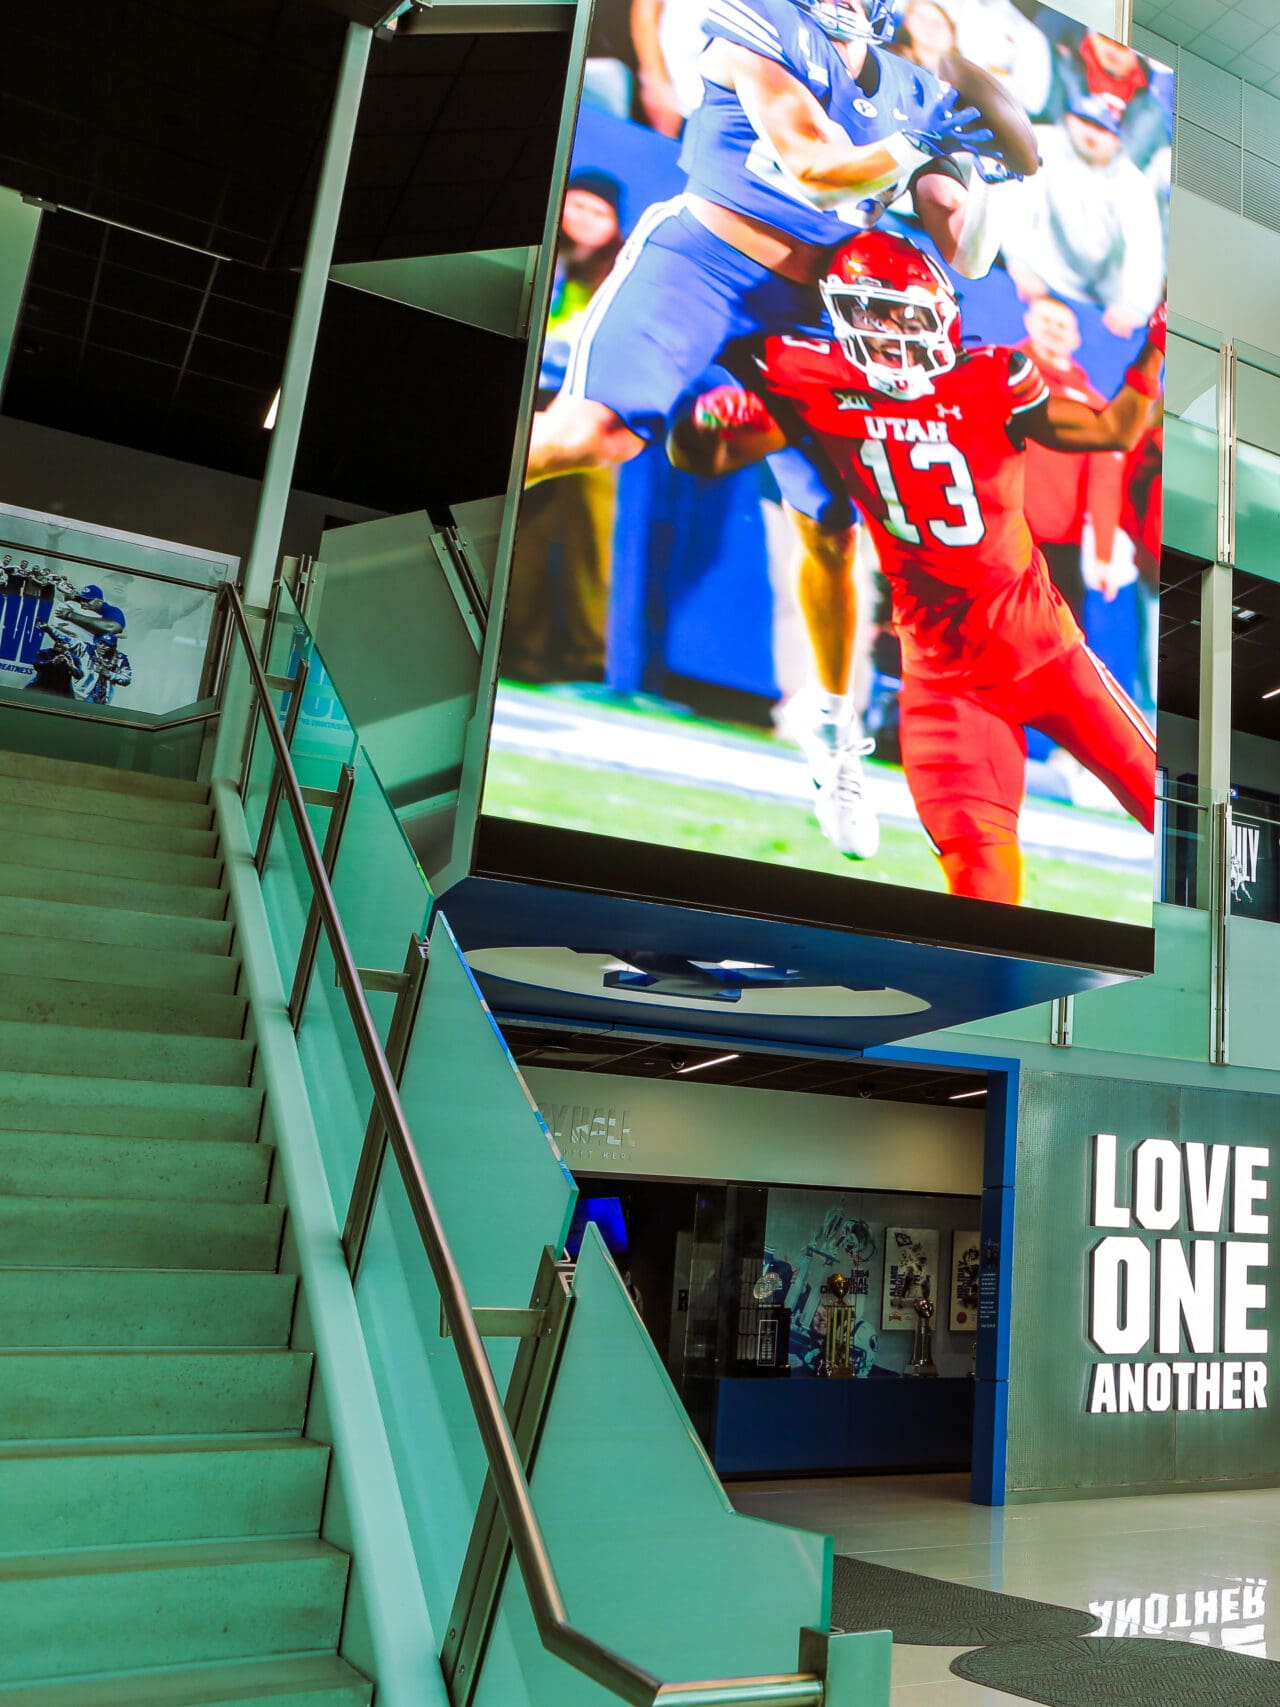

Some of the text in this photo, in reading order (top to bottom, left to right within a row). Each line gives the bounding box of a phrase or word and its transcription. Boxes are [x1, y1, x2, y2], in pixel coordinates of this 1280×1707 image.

[863, 415, 949, 442] UTAH
[859, 438, 987, 547] 13
[1093, 1133, 1270, 1235] LOVE
[1090, 1236, 1270, 1355] ONE
[1090, 1360, 1268, 1413] ANOTHER
